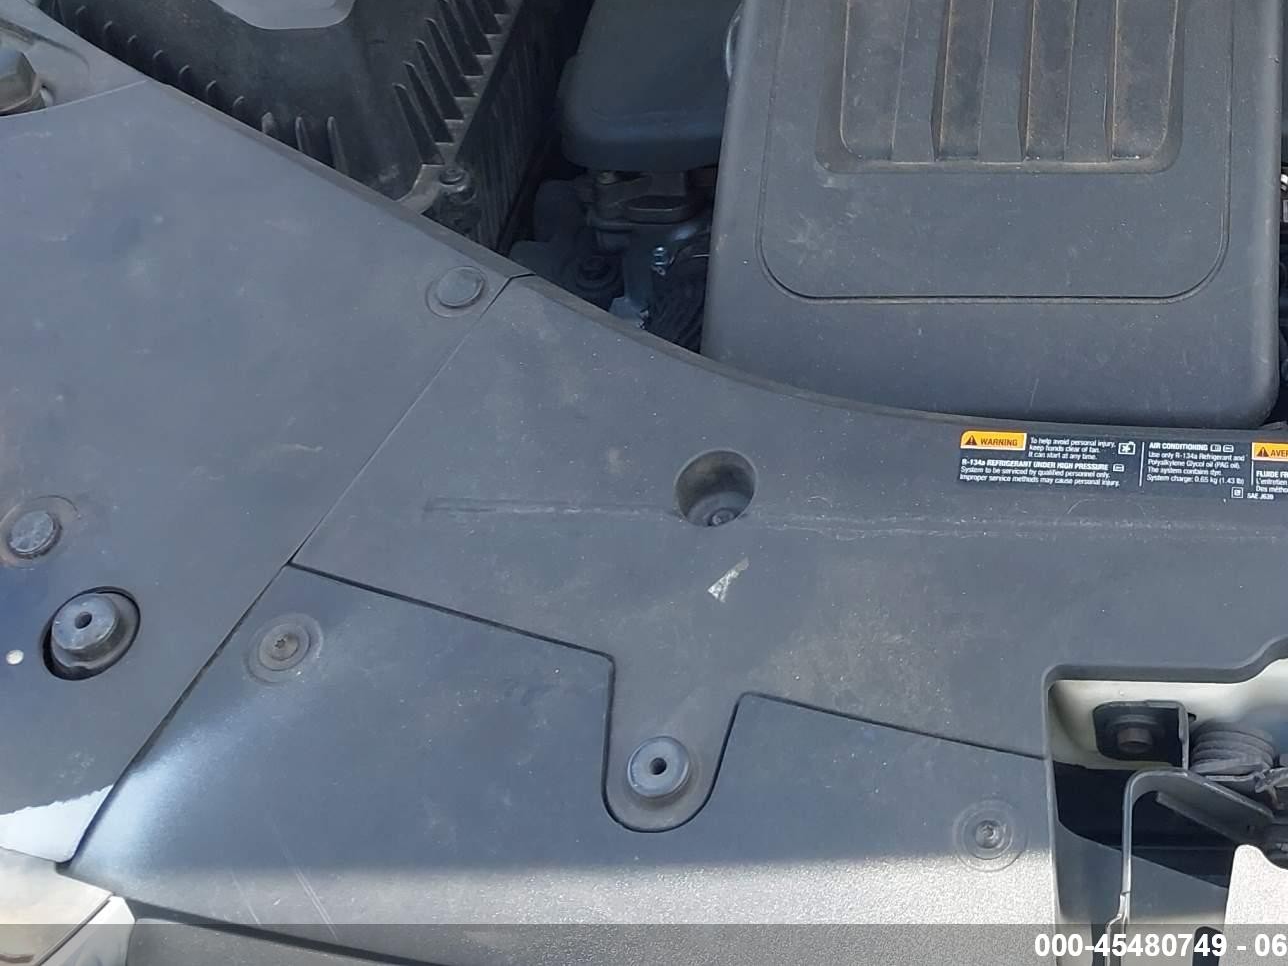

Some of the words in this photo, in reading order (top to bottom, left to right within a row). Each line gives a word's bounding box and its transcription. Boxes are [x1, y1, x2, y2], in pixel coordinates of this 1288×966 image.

[980, 439, 1018, 447] WARNING
[1039, 437, 1051, 446] help
[1071, 439, 1096, 447] personal
[1162, 442, 1208, 451] CONDITIONING
[1161, 452, 1174, 460] only
[1175, 452, 1197, 460] R-134a
[1199, 453, 1232, 462] Refrigerant
[962, 458, 986, 466] R-134a
[987, 459, 1032, 467] REFRIGERANT
[1034, 461, 1056, 469] UNDER
[1075, 463, 1109, 471] PRESSURE
[1148, 459, 1185, 467] Polyalkylene
[1186, 460, 1205, 468] Glycol
[961, 466, 983, 474] System
[1038, 469, 1063, 477] qualified
[1065, 470, 1095, 478] personnel
[960, 474, 987, 482] Improper
[1040, 477, 1053, 485] may
[1074, 478, 1100, 486] personal
[1147, 474, 1169, 482] System
